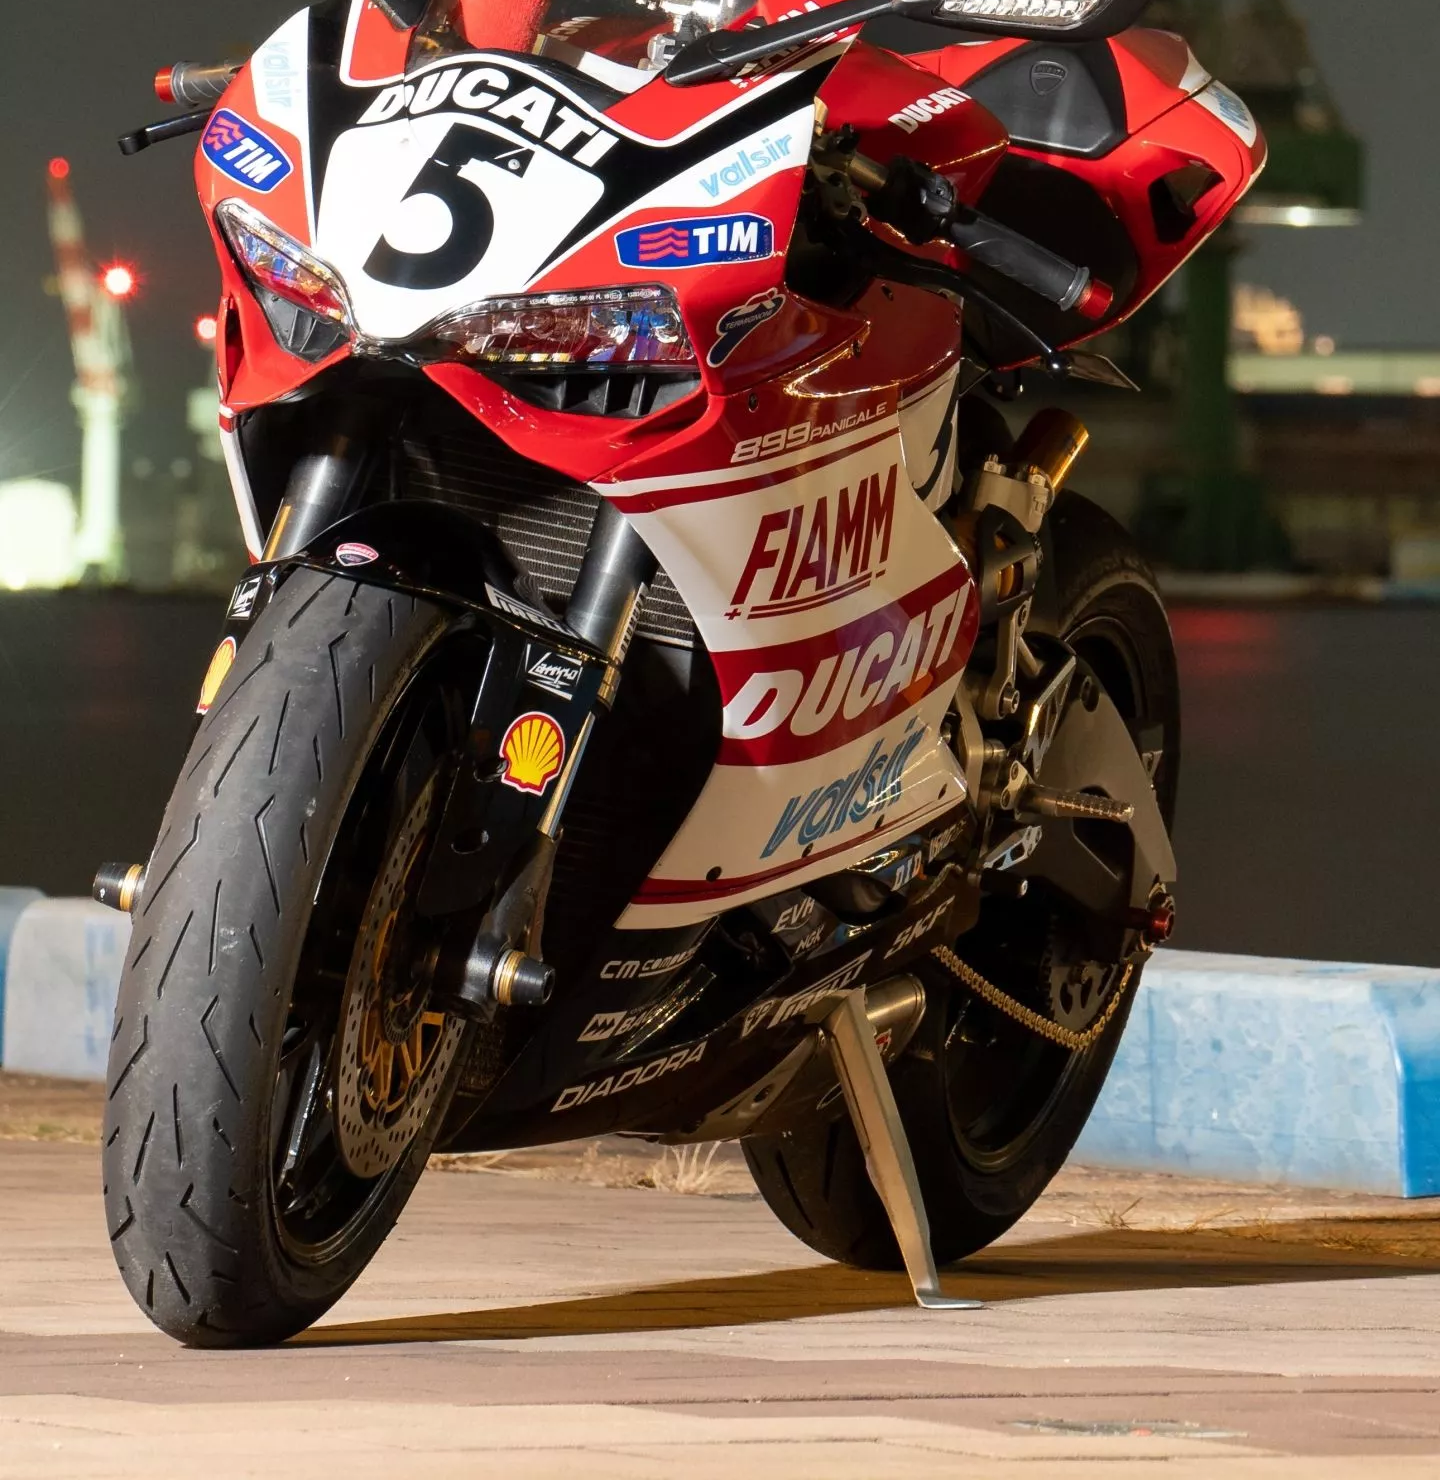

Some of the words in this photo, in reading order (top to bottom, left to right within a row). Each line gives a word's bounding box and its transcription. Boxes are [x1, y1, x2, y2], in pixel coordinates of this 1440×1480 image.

[263, 39, 296, 108] valsir
[356, 68, 619, 168] DUCATI
[888, 86, 972, 134] DUCATI
[223, 136, 282, 182] TIM
[700, 131, 792, 198] valsir
[362, 122, 536, 290] 5
[693, 221, 758, 255] TIM
[730, 422, 810, 463] 899
[810, 404, 886, 439] PANIGALE
[731, 464, 897, 606] FIAMM
[723, 586, 970, 739] DUCATI
[759, 714, 928, 859] valsir
[883, 895, 955, 960] SKF
[600, 960, 640, 979] CM
[551, 1041, 706, 1112] DIADORA
